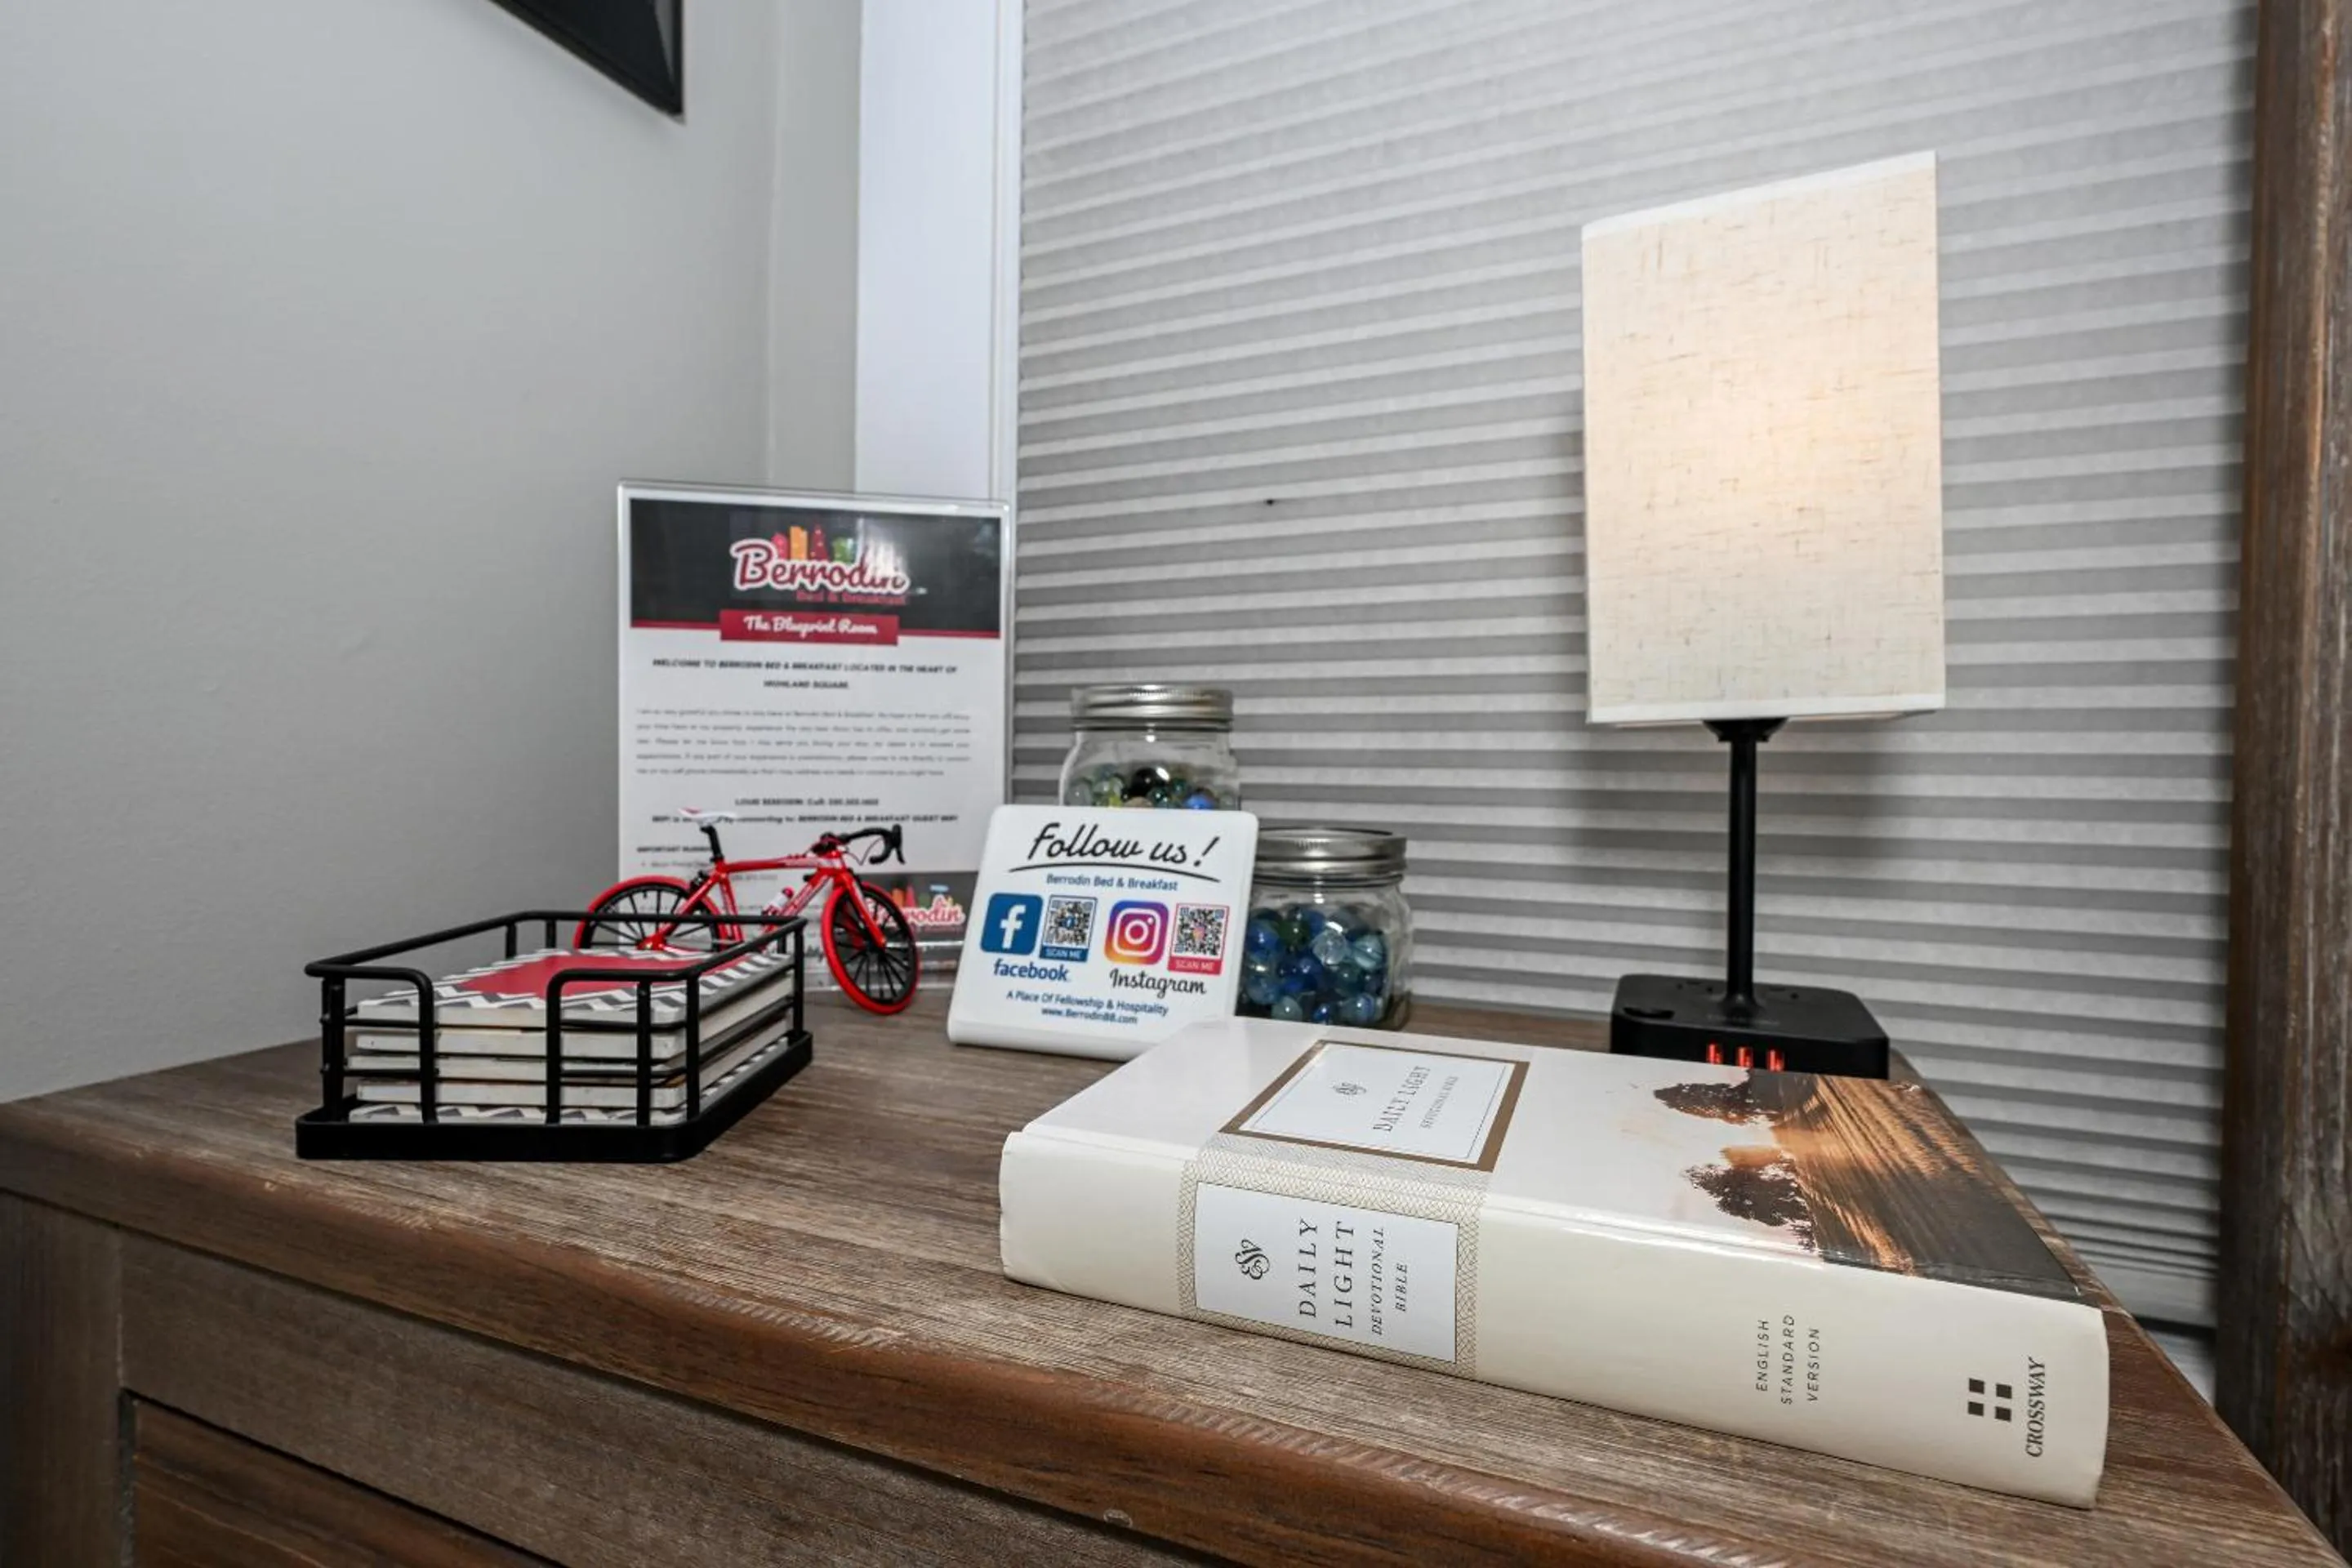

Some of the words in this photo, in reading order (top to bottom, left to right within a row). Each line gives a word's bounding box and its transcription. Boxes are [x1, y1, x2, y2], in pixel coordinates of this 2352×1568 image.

[743, 615, 770, 630] The
[773, 616, 836, 639] Blueprint
[838, 618, 878, 634] Room
[705, 659, 715, 668] TO
[844, 663, 885, 673] LOCATED
[898, 665, 914, 673] THE
[916, 666, 944, 674] HEART
[813, 680, 849, 689] SQUARE
[1027, 822, 1144, 861] Follow
[1047, 874, 1090, 885] Berrodin
[1094, 876, 1113, 887] Bed
[1116, 877, 1125, 888] &
[1128, 878, 1178, 890] Breakfast
[994, 958, 1069, 981] facebook
[1045, 948, 1067, 957] SCAN
[1069, 950, 1081, 959] ME
[1175, 959, 1199, 969] SCAN
[1201, 961, 1214, 970] ME
[1109, 968, 1207, 999] Instagram
[1006, 991, 1013, 999] A
[1015, 991, 1039, 1002] Place
[1041, 993, 1054, 1003] Of
[1054, 995, 1103, 1009] Fellowship
[1106, 999, 1114, 1009] &
[1116, 1000, 1169, 1018] Hospitality
[1373, 1098, 1410, 1132] DAILY
[1397, 1066, 1431, 1095] LIGHT
[1298, 1218, 1318, 1319] DAILY
[1333, 1220, 1355, 1329] LIGHT
[1371, 1227, 1385, 1336] DEVOTIONAL
[1394, 1263, 1409, 1313] BIBLE
[1756, 1320, 1769, 1392] ENGLISH
[1780, 1315, 1794, 1405] STANDARD
[1806, 1329, 1820, 1401] VERSION
[2025, 1356, 2045, 1458] CROSSWAY
